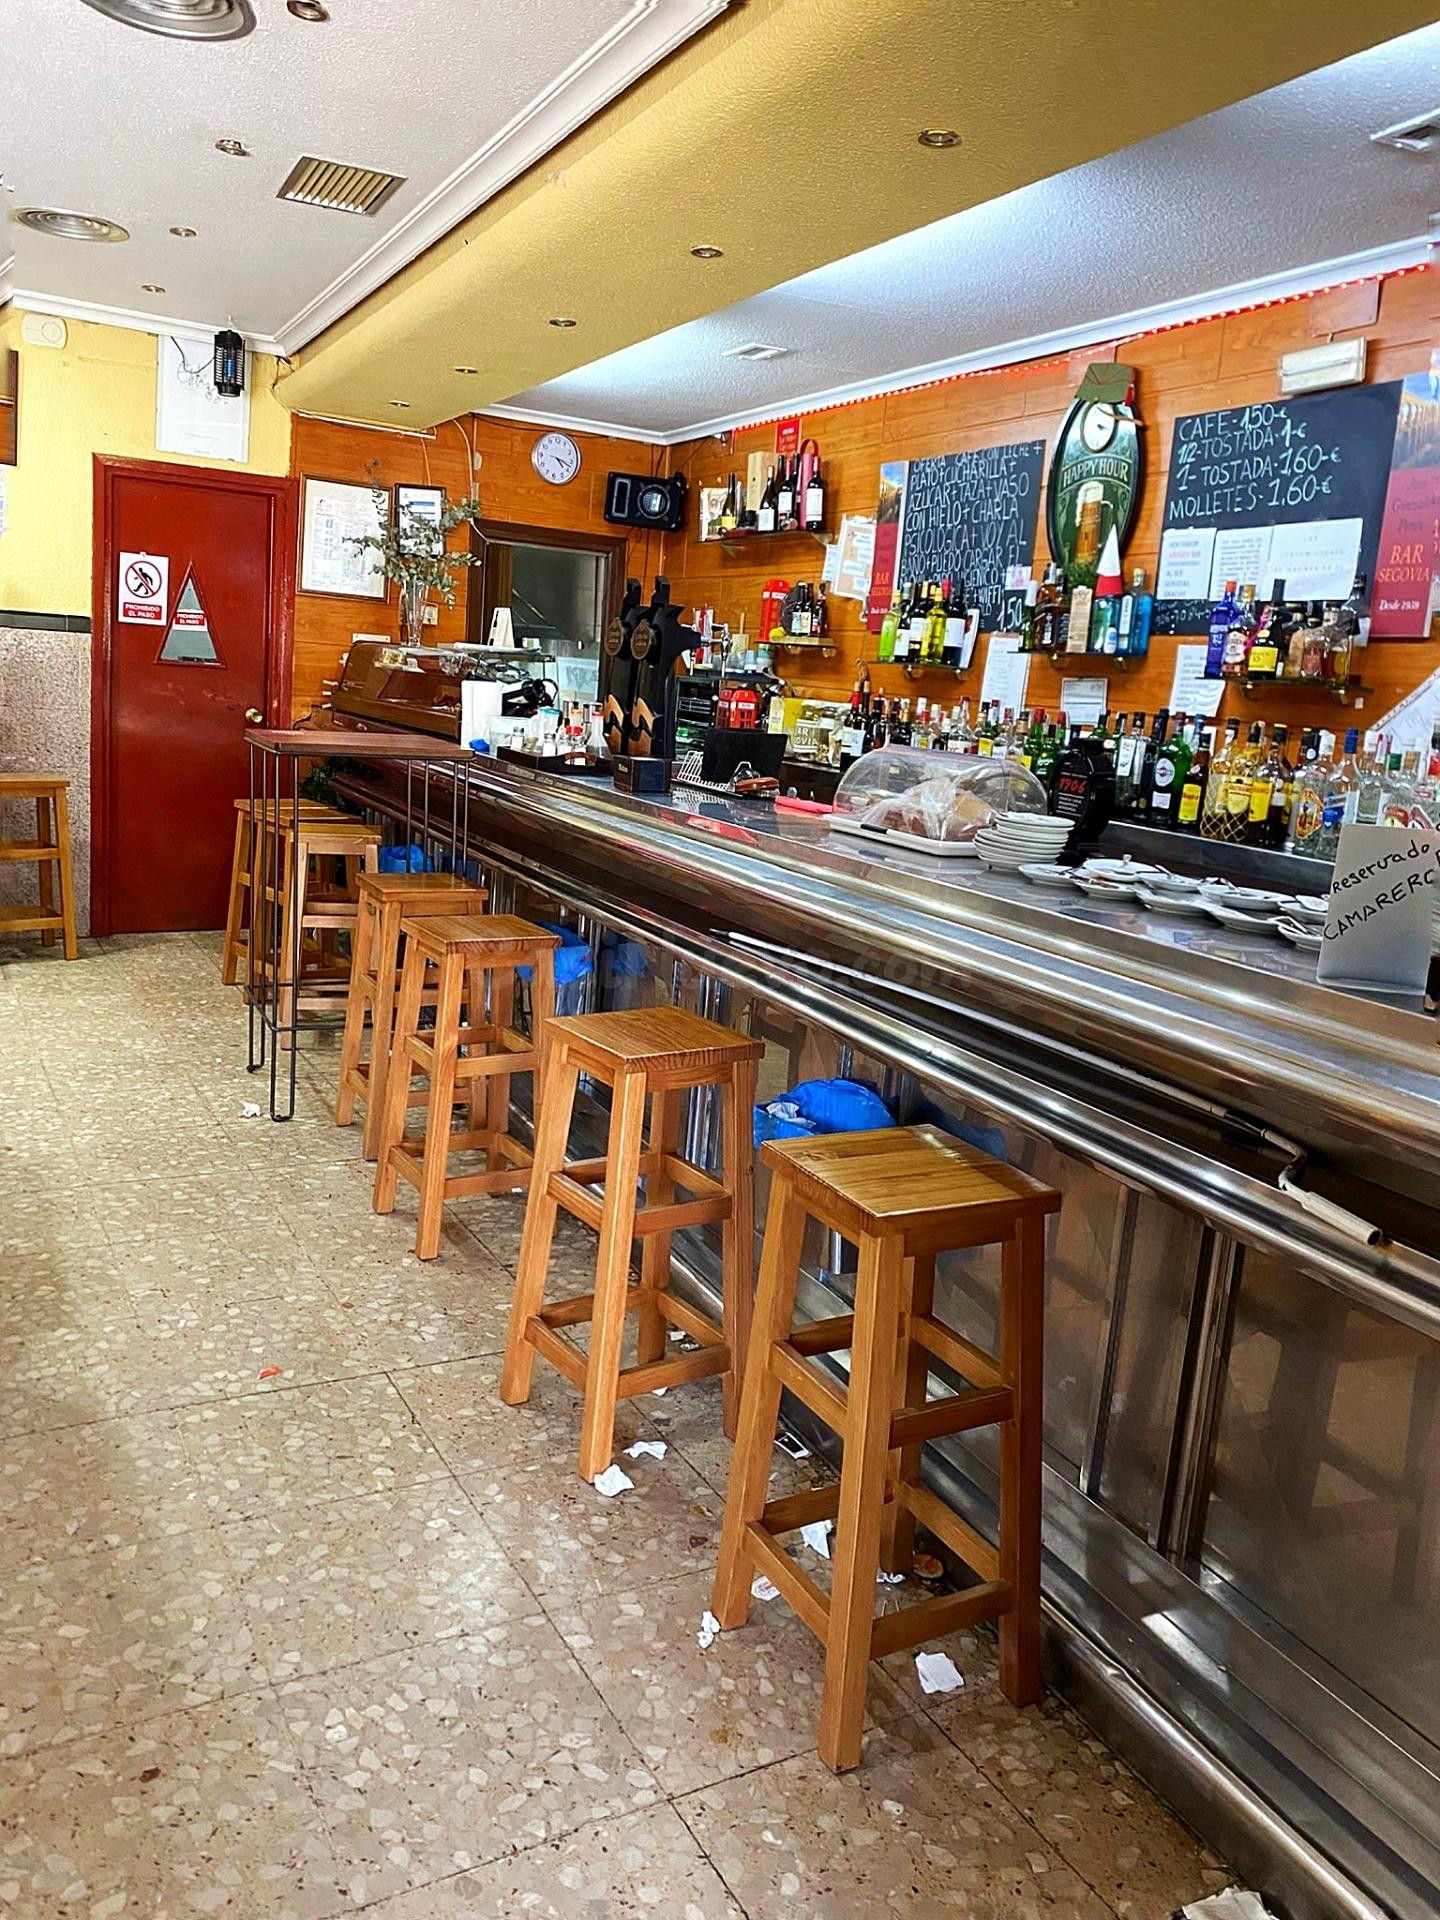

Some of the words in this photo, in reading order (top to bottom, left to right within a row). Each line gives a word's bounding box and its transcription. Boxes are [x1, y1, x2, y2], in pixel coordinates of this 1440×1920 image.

[1063, 458, 1098, 488] HAPPY
[1099, 458, 1128, 482] HOUR
[906, 511, 925, 532] CON
[1006, 519, 1027, 546] AL
[1391, 544, 1423, 564] BAR
[1378, 567, 1429, 583] SEGOVIA
[125, 603, 160, 612] PROHIBIDO
[137, 610, 155, 619] PASO
[1059, 777, 1087, 794] 1906
